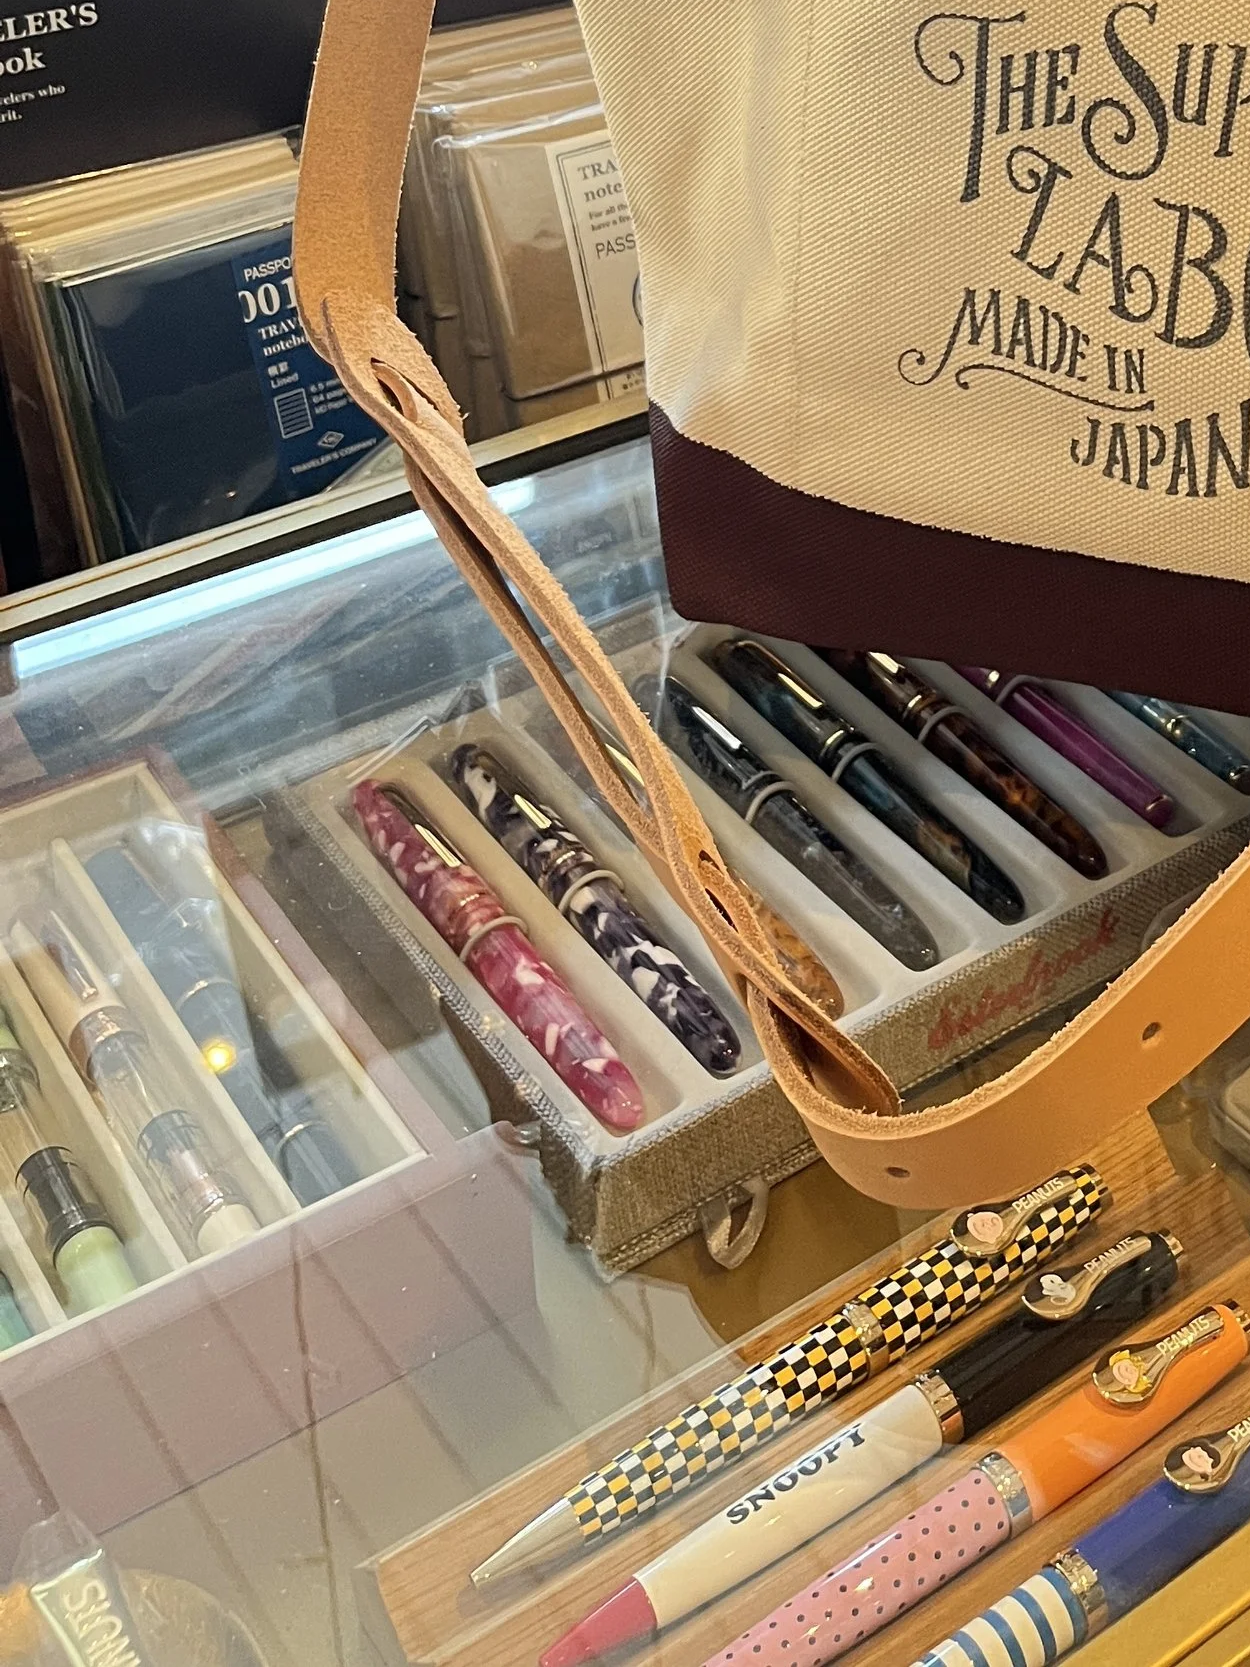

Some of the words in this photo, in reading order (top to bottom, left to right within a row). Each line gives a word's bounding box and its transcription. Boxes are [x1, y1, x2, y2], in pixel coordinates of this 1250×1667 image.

[0, 2, 98, 42] LER'S
[0, 91, 35, 106] elers
[38, 84, 66, 97] who
[914, 9, 1083, 203] THE
[577, 159, 618, 181] TRA
[584, 182, 624, 202] note
[595, 233, 637, 260] PASS
[243, 256, 291, 282] PASSPO
[258, 317, 298, 340] TRAV
[898, 287, 1090, 386] MADE
[1104, 344, 1147, 395] IN
[1011, 1176, 1065, 1214] PEANUTS
[1083, 1236, 1137, 1276] PEANUTS
[1156, 1315, 1212, 1358] PEANUTS
[726, 1423, 868, 1527] SNOOPY
